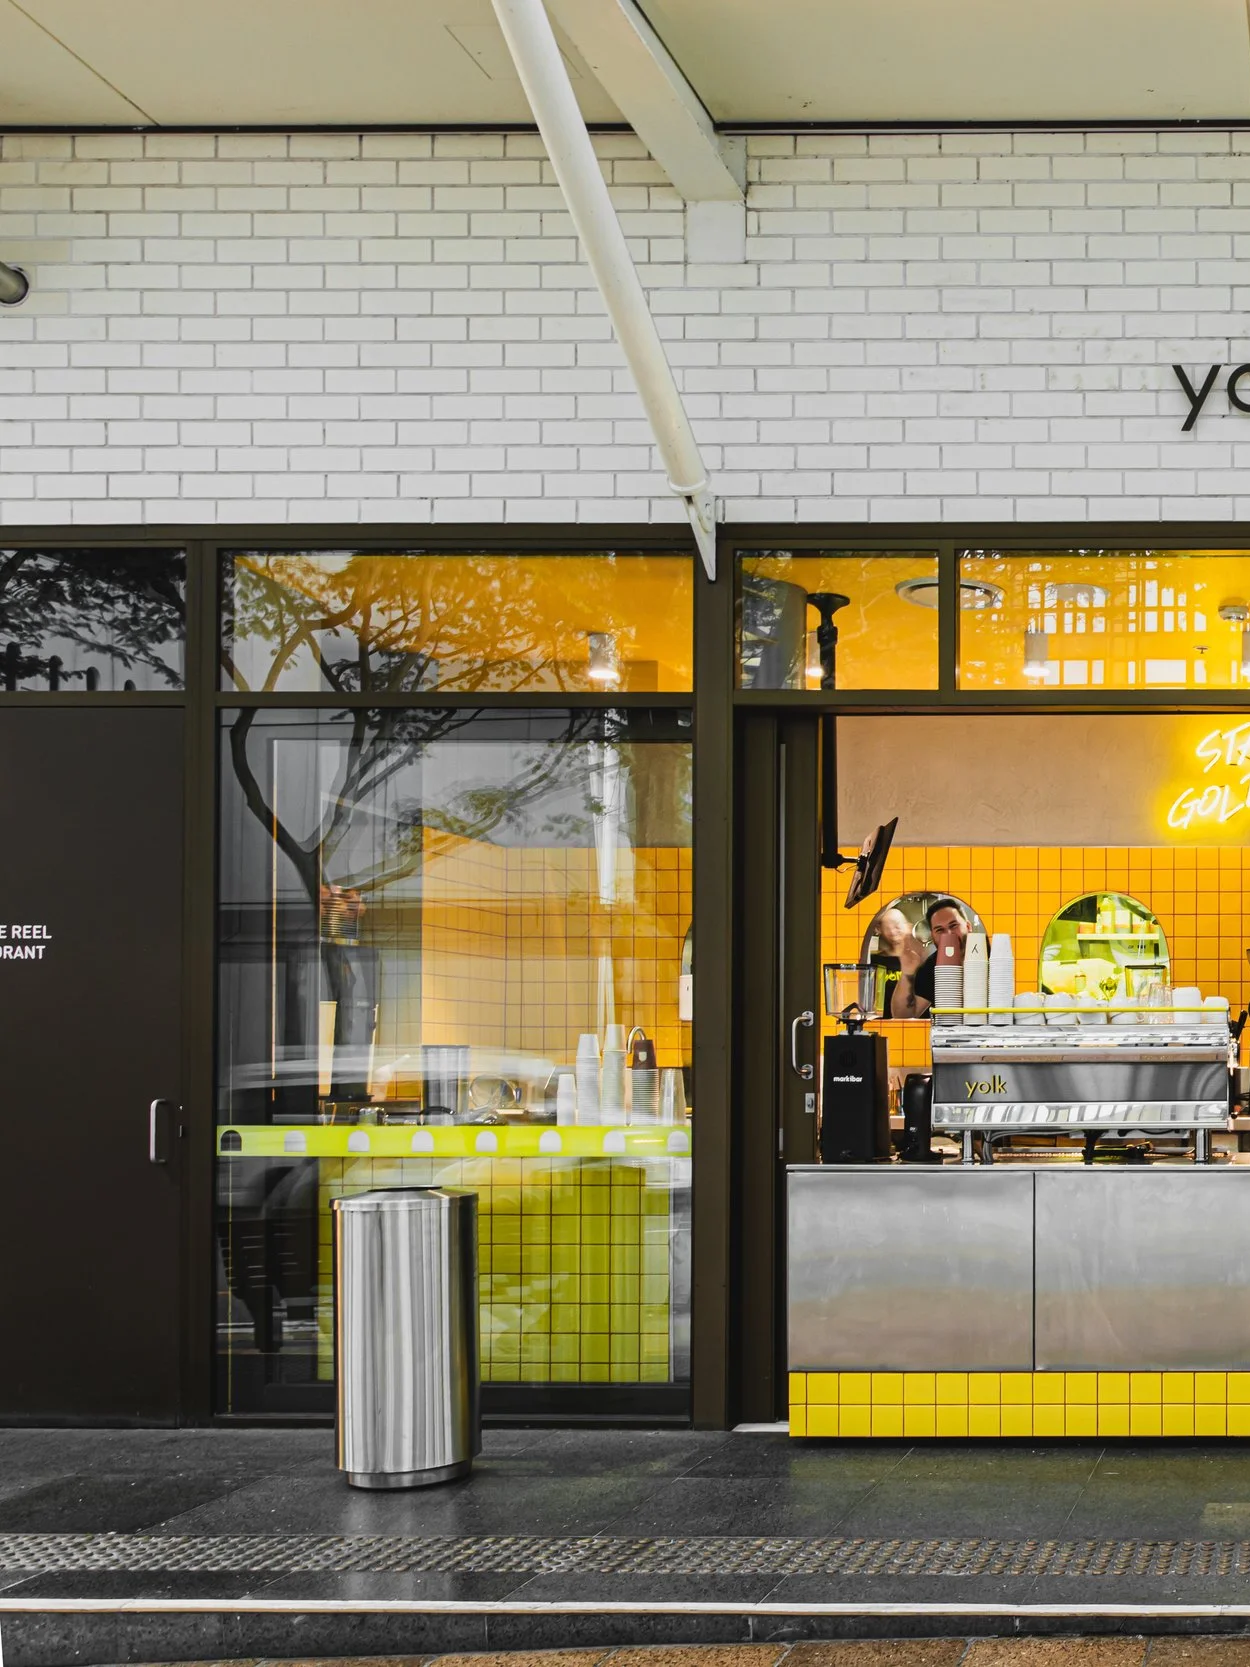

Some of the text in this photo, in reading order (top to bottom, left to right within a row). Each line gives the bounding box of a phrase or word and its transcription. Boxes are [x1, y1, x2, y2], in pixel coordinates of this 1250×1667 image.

[11, 925, 52, 939] REEL
[0, 945, 46, 960] RANT
[965, 1075, 1007, 1099] yolk
